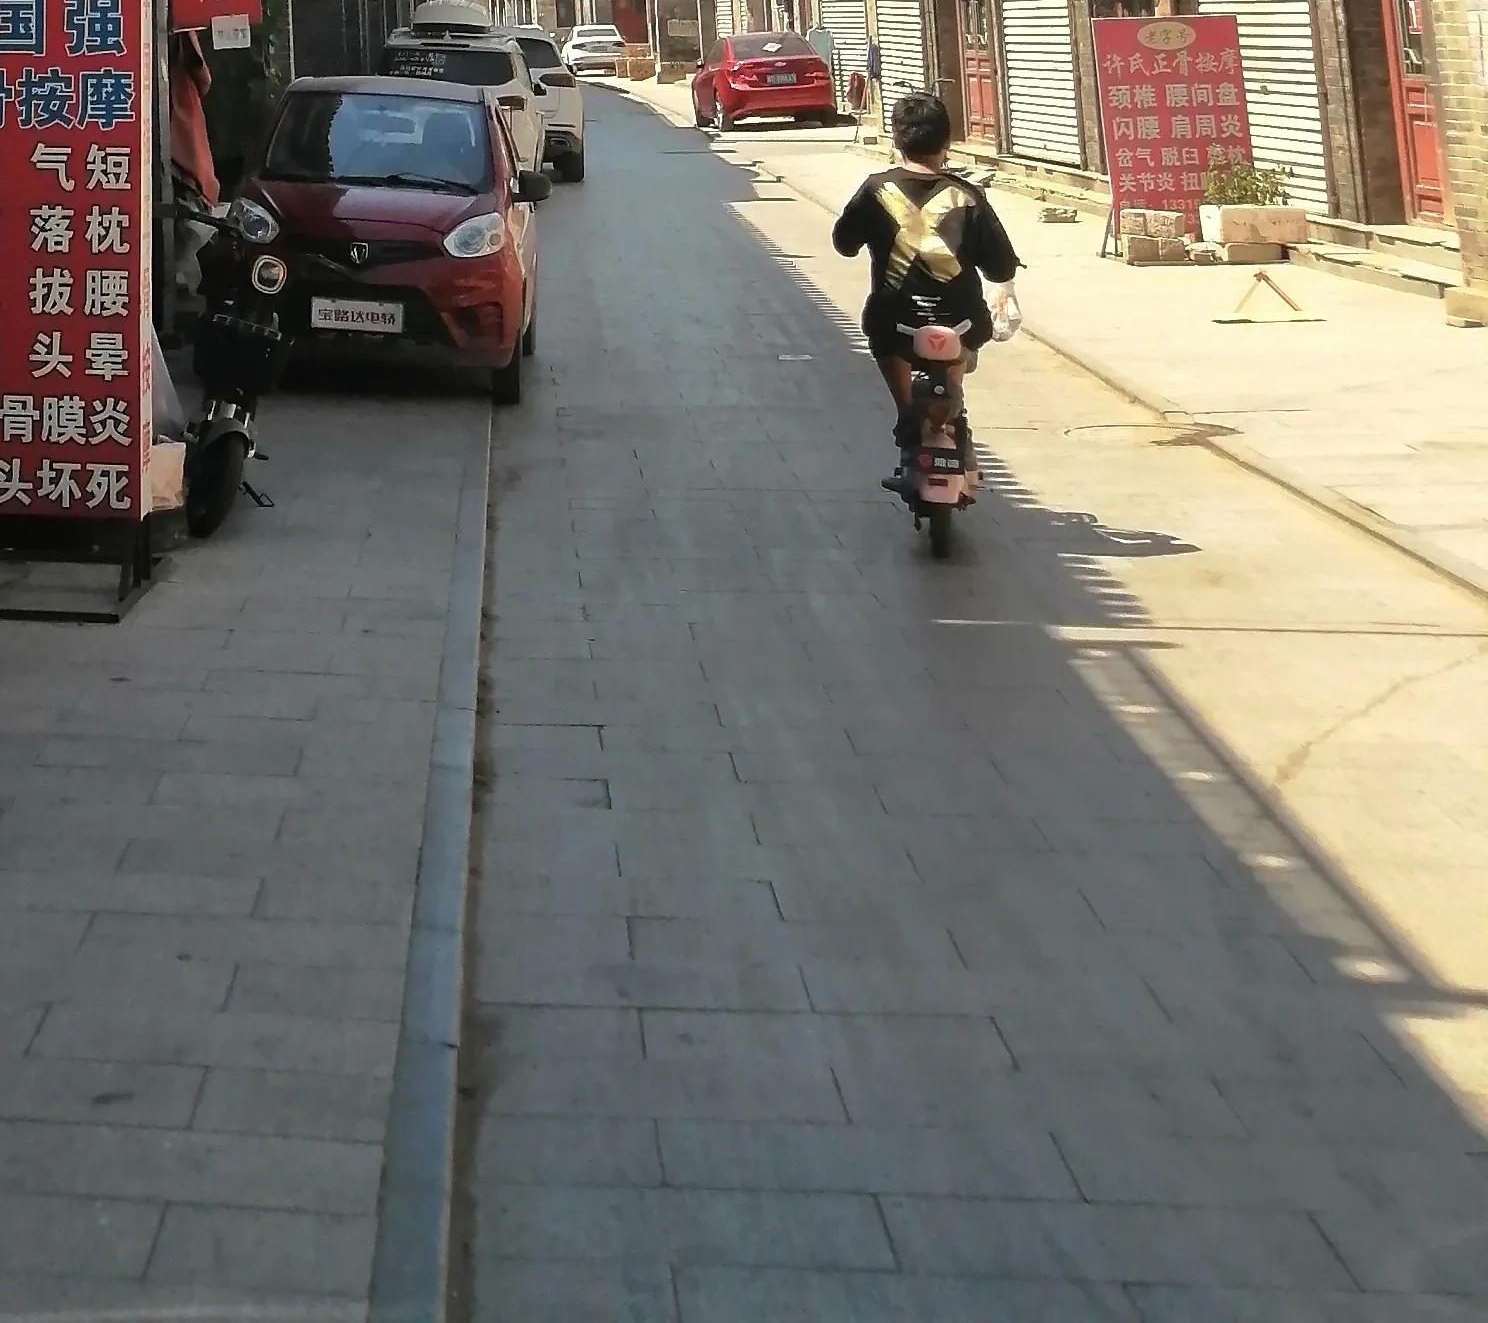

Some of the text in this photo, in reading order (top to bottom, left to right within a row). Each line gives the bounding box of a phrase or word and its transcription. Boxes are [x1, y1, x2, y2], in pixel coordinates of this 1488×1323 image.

[1102, 48, 1239, 78] 许氏正骨按摩
[1108, 82, 1241, 110] 颈椎 腰间盘
[1112, 114, 1244, 141] 闪腰 肩周炎
[29, 143, 131, 192] 气短
[1115, 147, 1155, 168] 岔气
[1119, 172, 1176, 193] 关节炎
[29, 205, 130, 254] 落枕
[28, 268, 129, 318] 拔腰
[29, 331, 129, 382] 头晕
